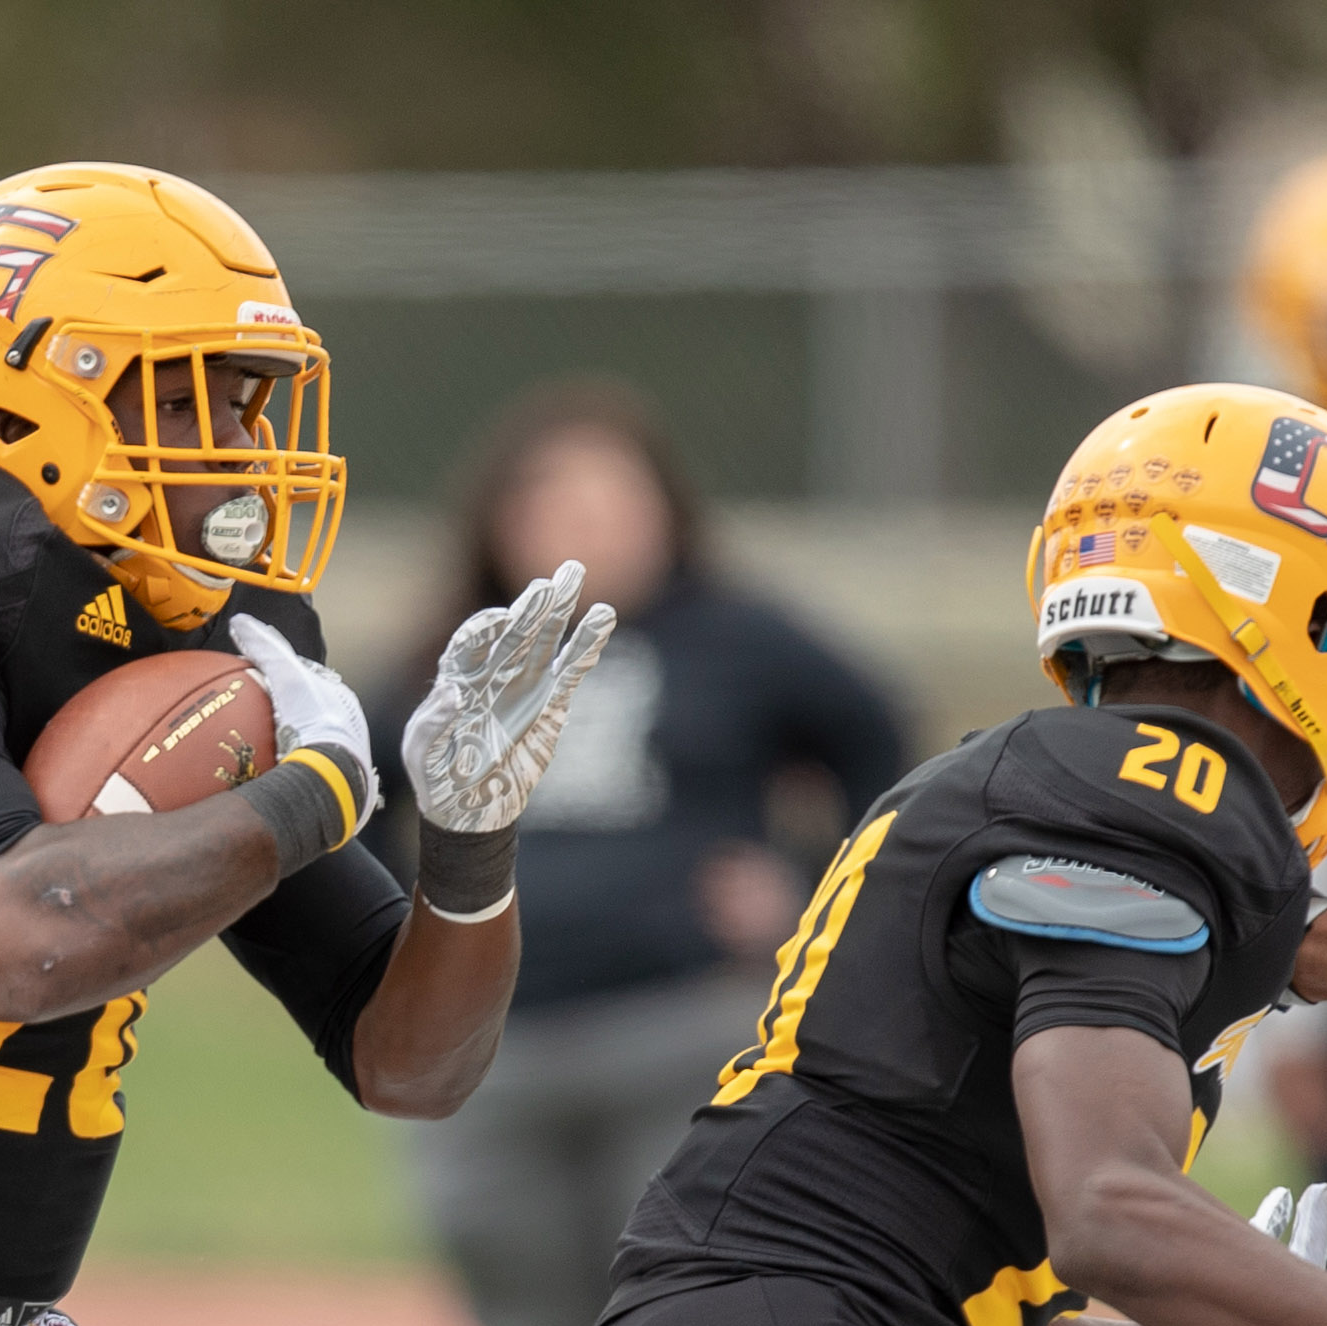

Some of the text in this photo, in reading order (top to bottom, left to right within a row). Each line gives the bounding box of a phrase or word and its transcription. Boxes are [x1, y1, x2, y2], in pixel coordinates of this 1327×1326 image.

[76, 613, 133, 648] adidas
[200, 689, 237, 719] TEAM
[161, 711, 204, 752] ISSUE
[1117, 721, 1228, 815] 20
